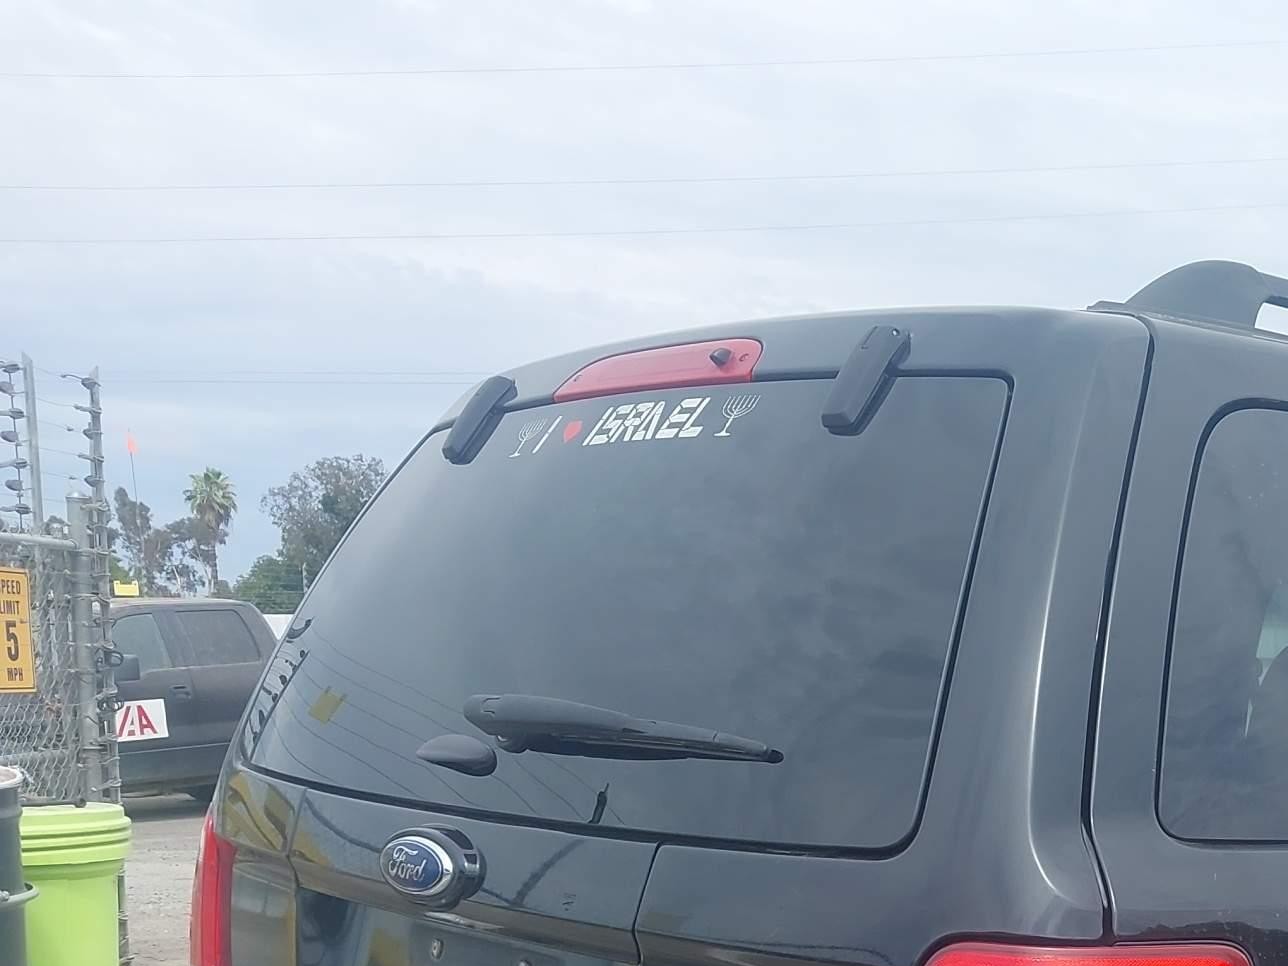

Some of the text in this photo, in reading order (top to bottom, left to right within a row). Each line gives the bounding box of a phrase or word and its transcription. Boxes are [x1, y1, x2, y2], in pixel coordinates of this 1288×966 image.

[582, 396, 711, 446] ISRAEL
[0, 579, 21, 594] PEED
[5, 620, 19, 661] 5
[7, 667, 24, 681] MPH
[388, 845, 427, 882] Ford
